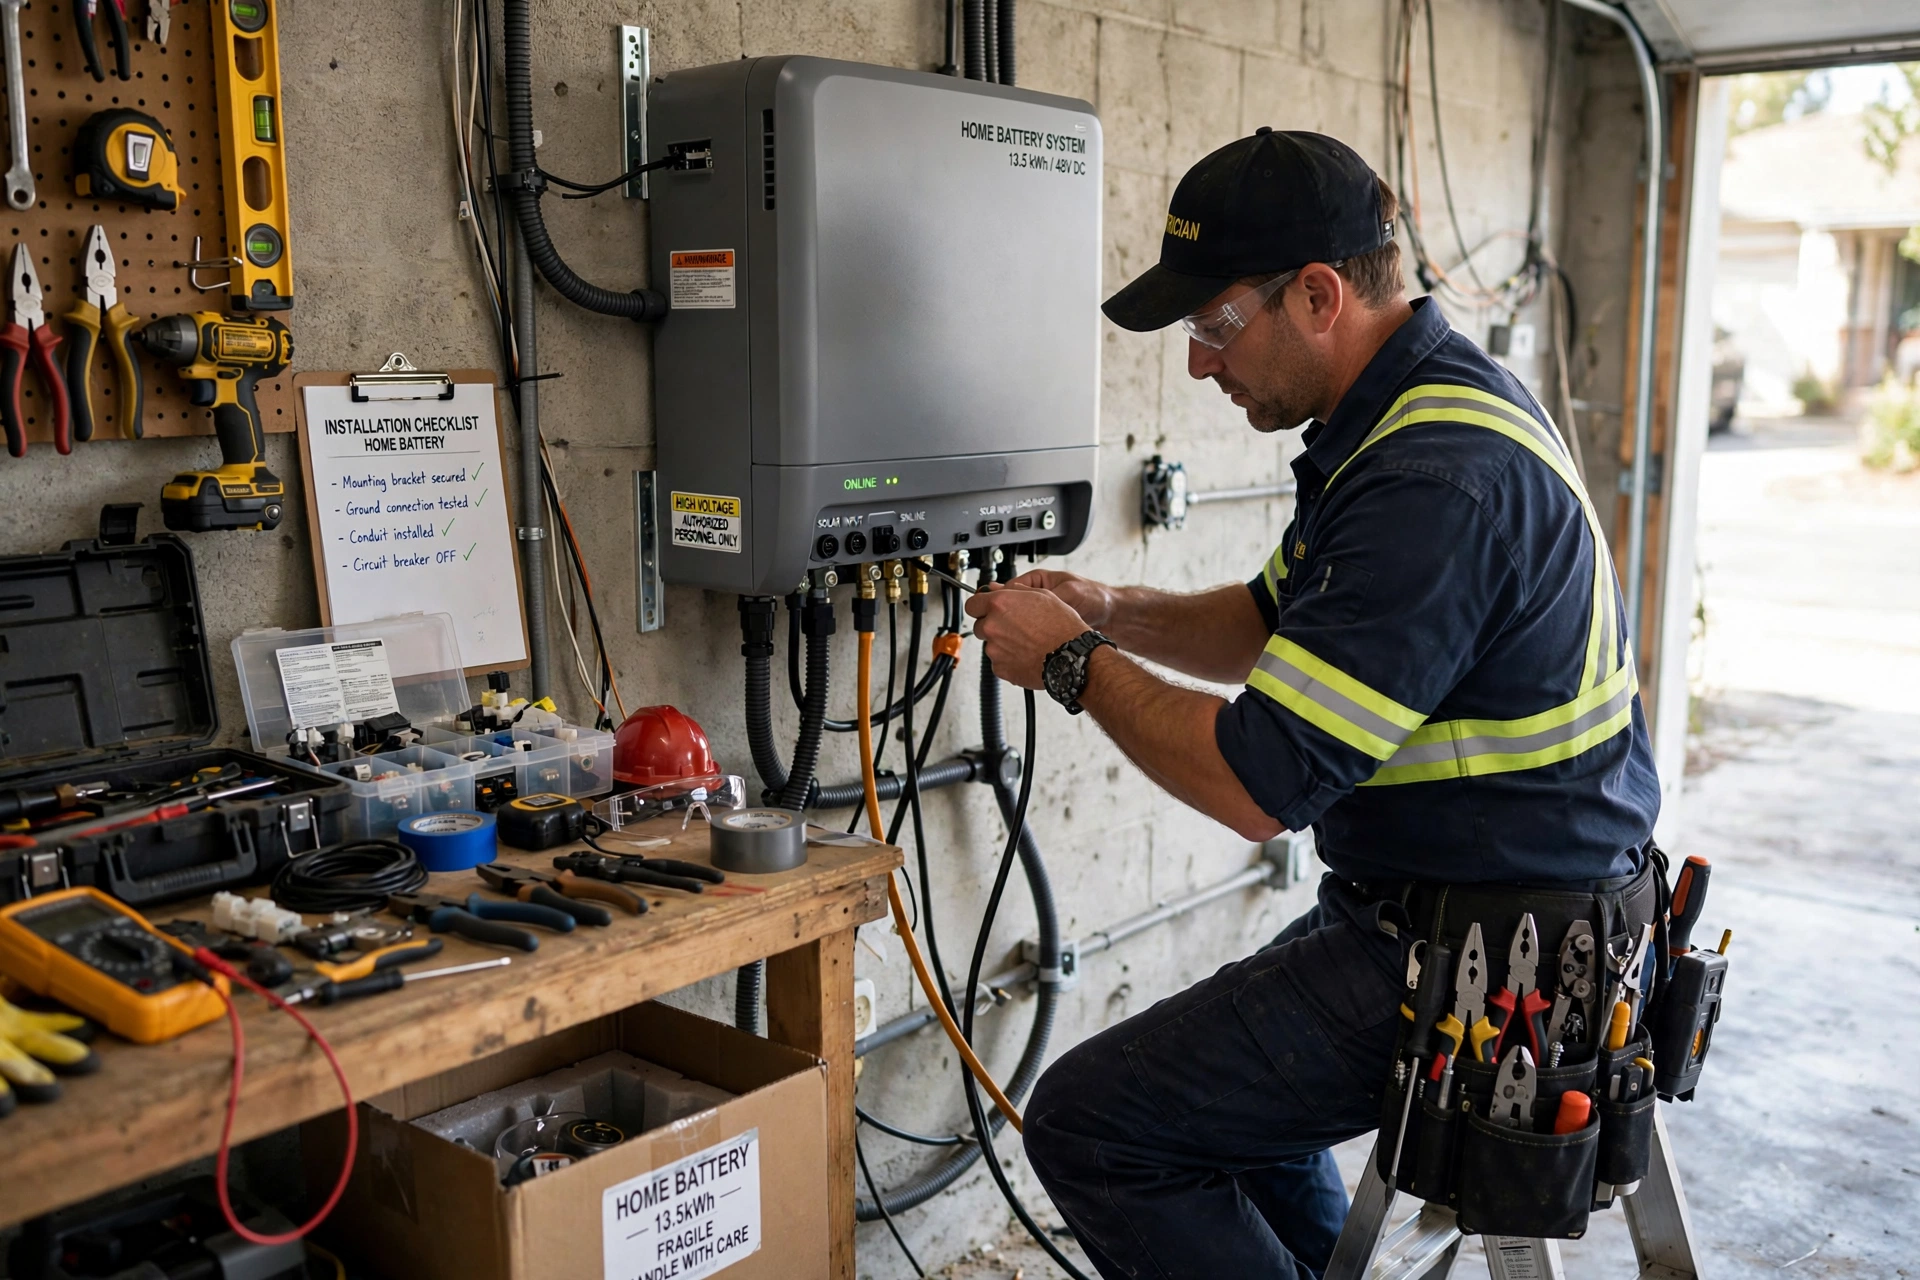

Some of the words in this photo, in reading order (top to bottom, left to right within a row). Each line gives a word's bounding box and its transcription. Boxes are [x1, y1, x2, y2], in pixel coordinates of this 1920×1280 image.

[961, 120, 994, 142] HOME
[997, 125, 1044, 149] BATTERY
[1046, 133, 1086, 155] SYSTEM
[1009, 152, 1028, 168] 13.5
[1029, 154, 1049, 171] kWh
[1055, 159, 1073, 174] 48V
[1073, 161, 1086, 176] DC
[324, 417, 412, 435] INSTALLATION
[414, 416, 479, 432] CHECKLIST
[364, 437, 397, 451] HOME
[399, 435, 445, 451] BATTERY
[342, 474, 387, 493] Mounting
[391, 470, 426, 486] bracket
[431, 467, 467, 484] secured
[843, 477, 878, 490] ONLINE
[346, 500, 381, 516] Ground
[386, 498, 435, 513] connection
[437, 494, 469, 509] tested
[675, 495, 696, 511] HIGH
[697, 499, 735, 515] VOLTAGE
[349, 528, 388, 544] Conduit
[393, 523, 435, 541] installed
[718, 532, 738, 548] ONLY
[353, 554, 389, 571] Circuit
[393, 552, 431, 568] breaker
[435, 549, 457, 564] OFF
[615, 1177, 670, 1221] HOME
[675, 1143, 750, 1196] BATTERY
[655, 1191, 715, 1234] 13.5kWh
[657, 1220, 714, 1262] FRAGILE
[631, 1258, 680, 1280] NDLE
[682, 1241, 714, 1270] WITH
[716, 1225, 749, 1254] CARE
